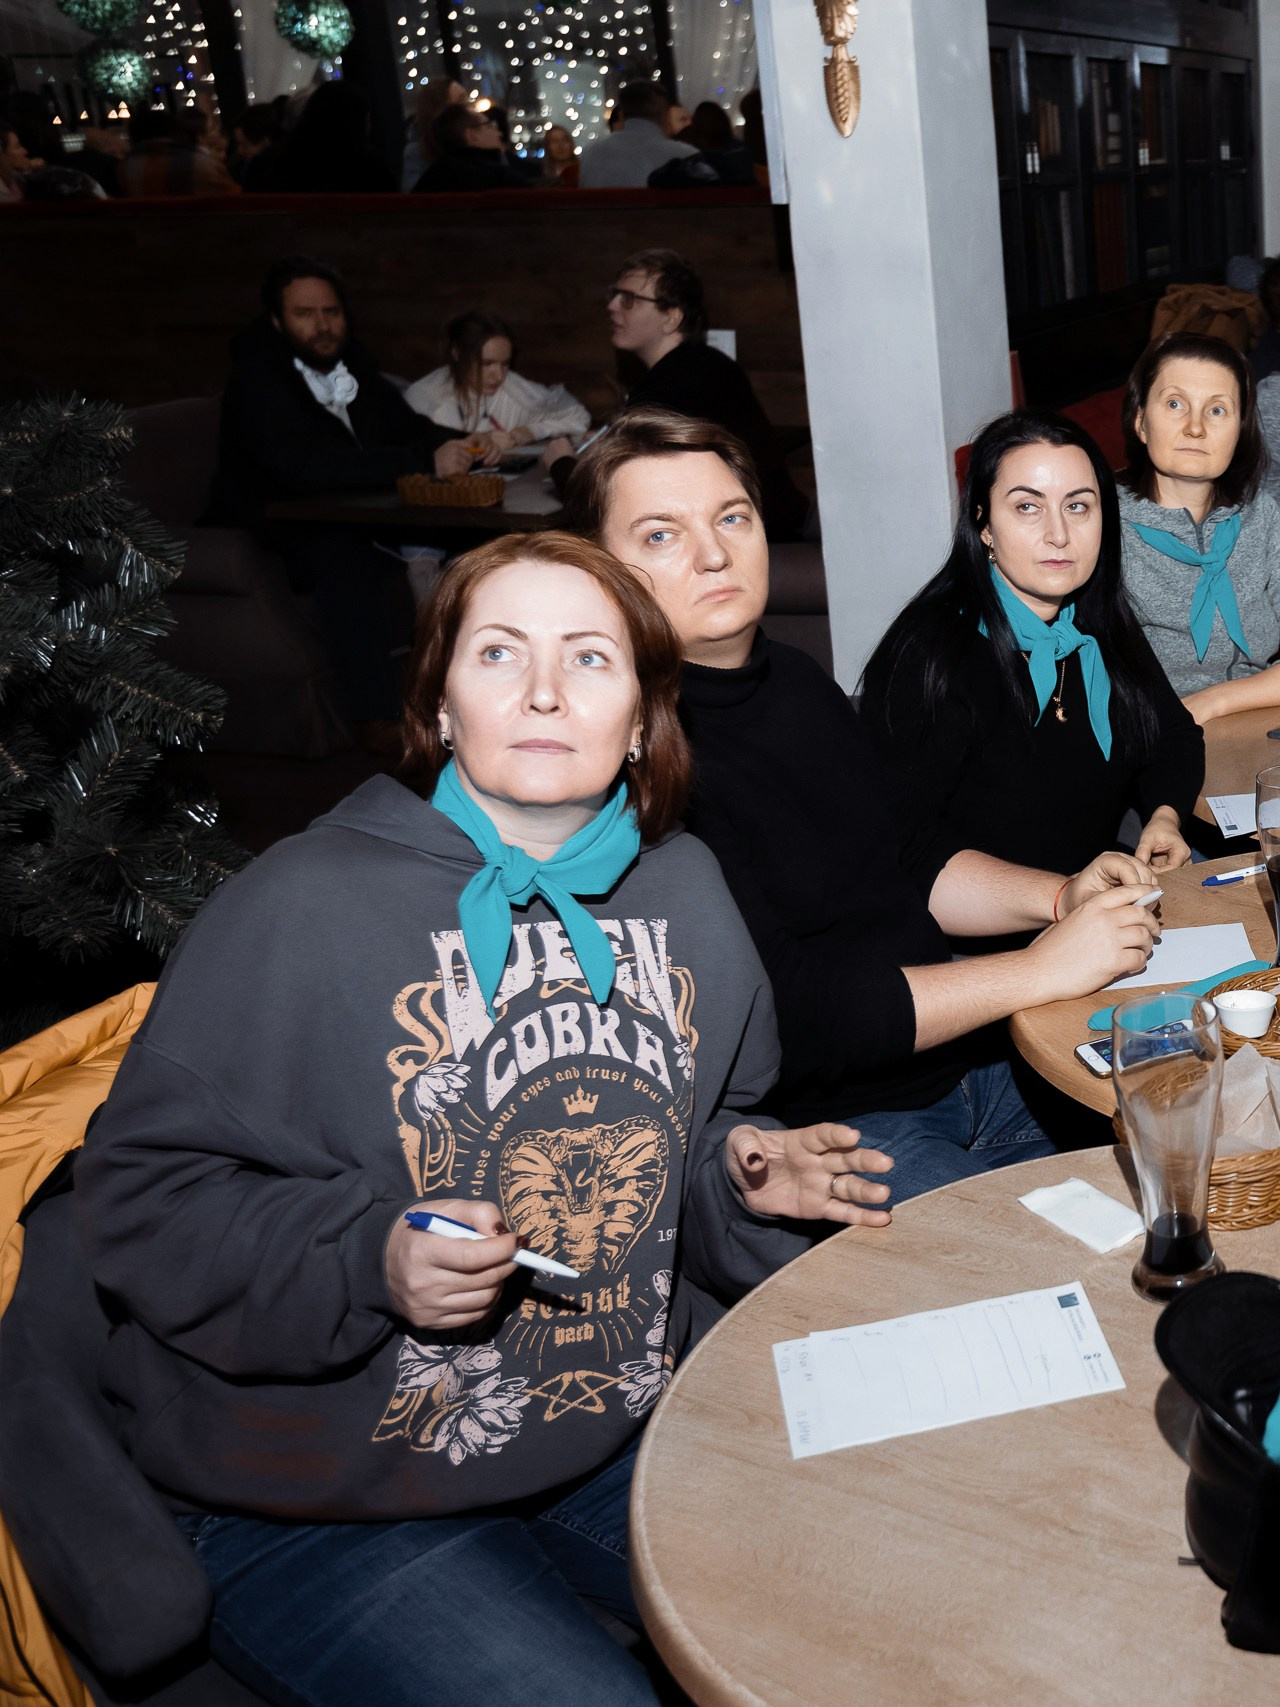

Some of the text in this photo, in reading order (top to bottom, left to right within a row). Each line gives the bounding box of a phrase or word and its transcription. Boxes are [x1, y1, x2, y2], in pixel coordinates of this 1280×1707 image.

[485, 1002, 675, 1112] COBRA
[470, 1149, 491, 1196] close
[487, 1103, 518, 1141] your
[521, 1076, 551, 1102] eyes
[555, 1066, 581, 1082] and
[585, 1066, 628, 1083] trust
[632, 1077, 664, 1103] your
